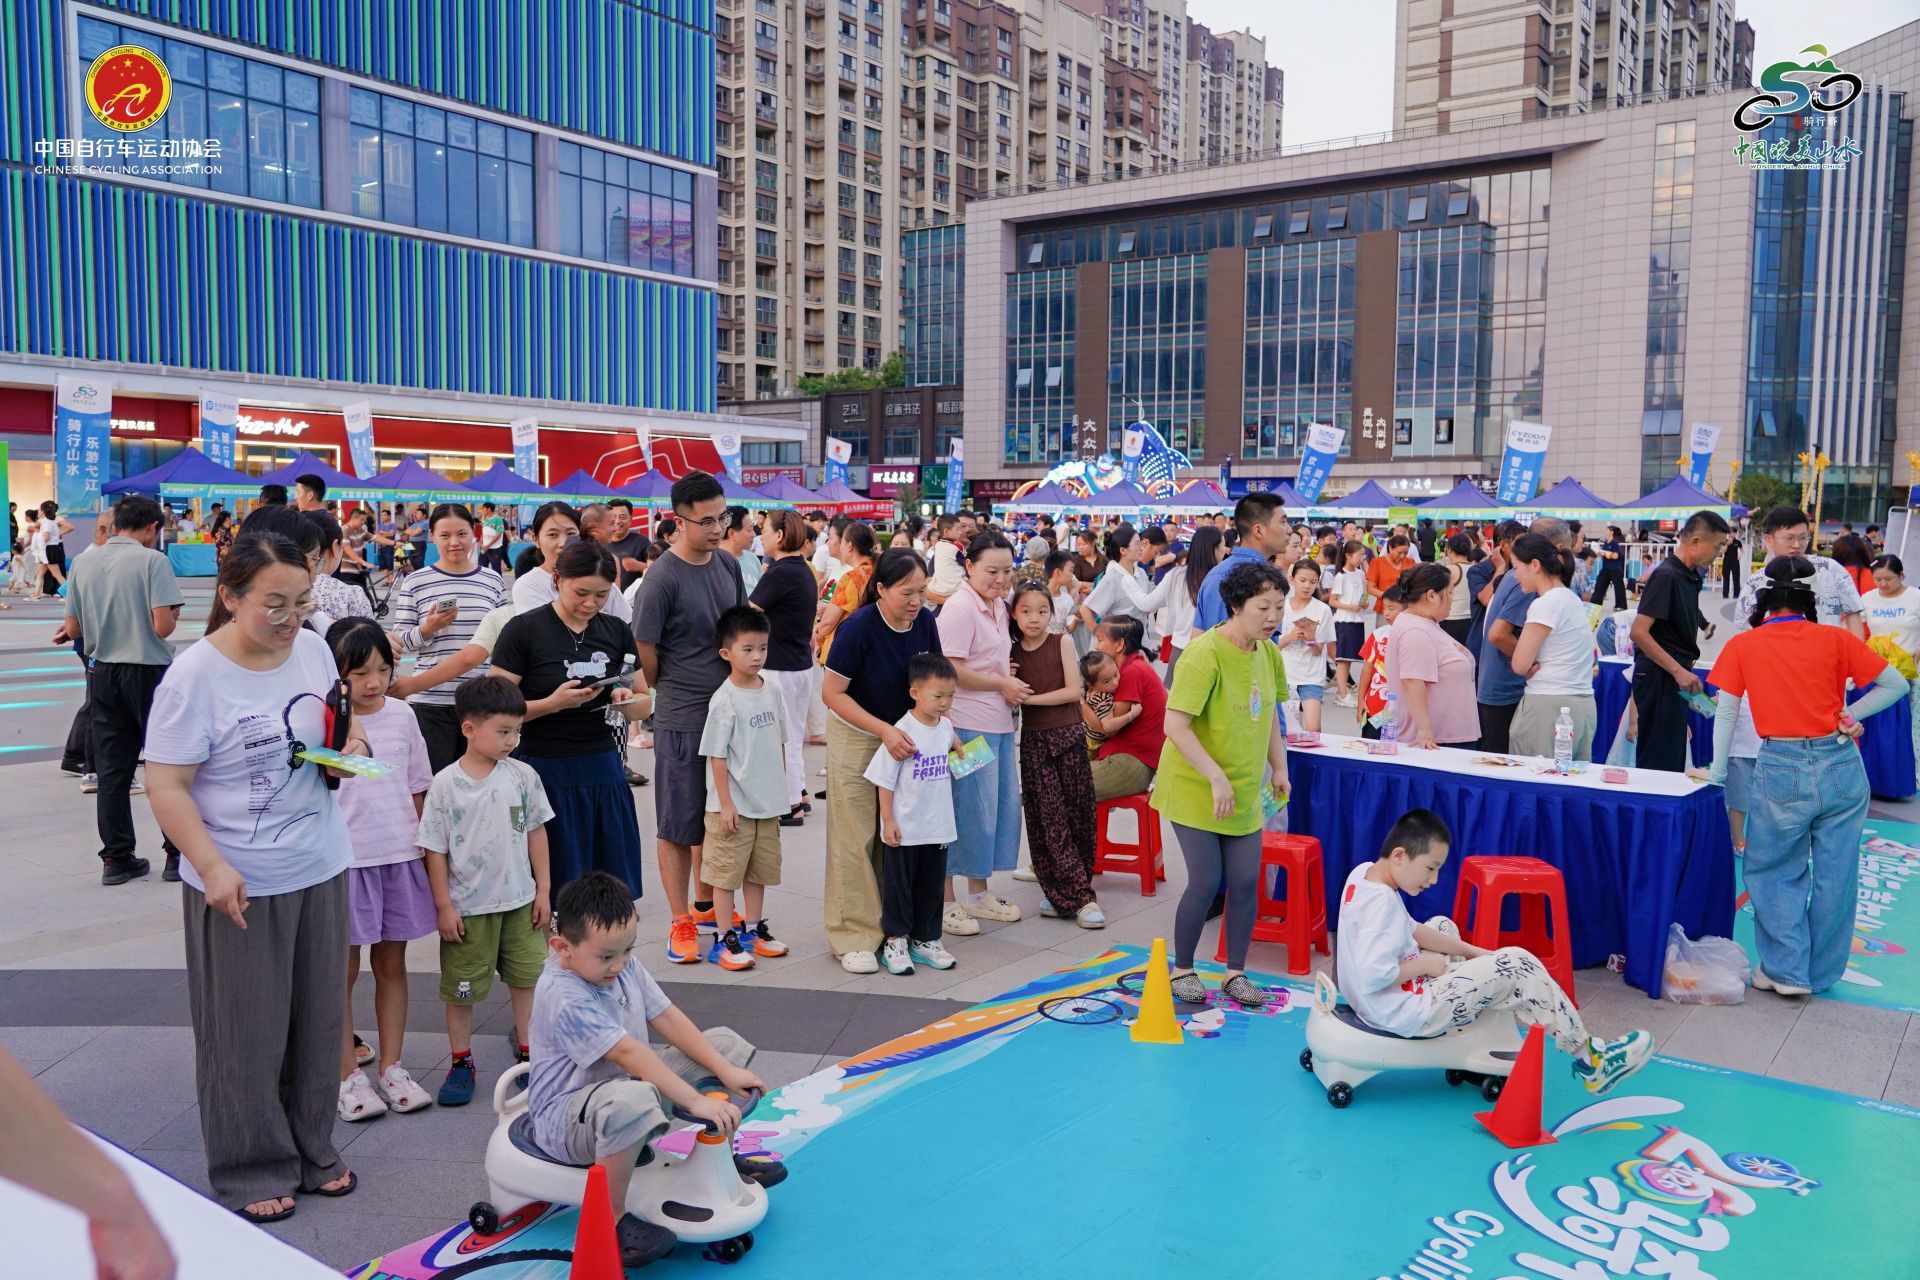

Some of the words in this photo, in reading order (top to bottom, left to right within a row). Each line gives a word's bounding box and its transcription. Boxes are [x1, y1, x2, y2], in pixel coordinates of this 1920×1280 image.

[842, 403, 859, 416] 艺朵
[885, 402, 921, 416] 绘画书法
[66, 418, 82, 476] 骑行山水
[84, 436, 100, 492] 乐游弋江
